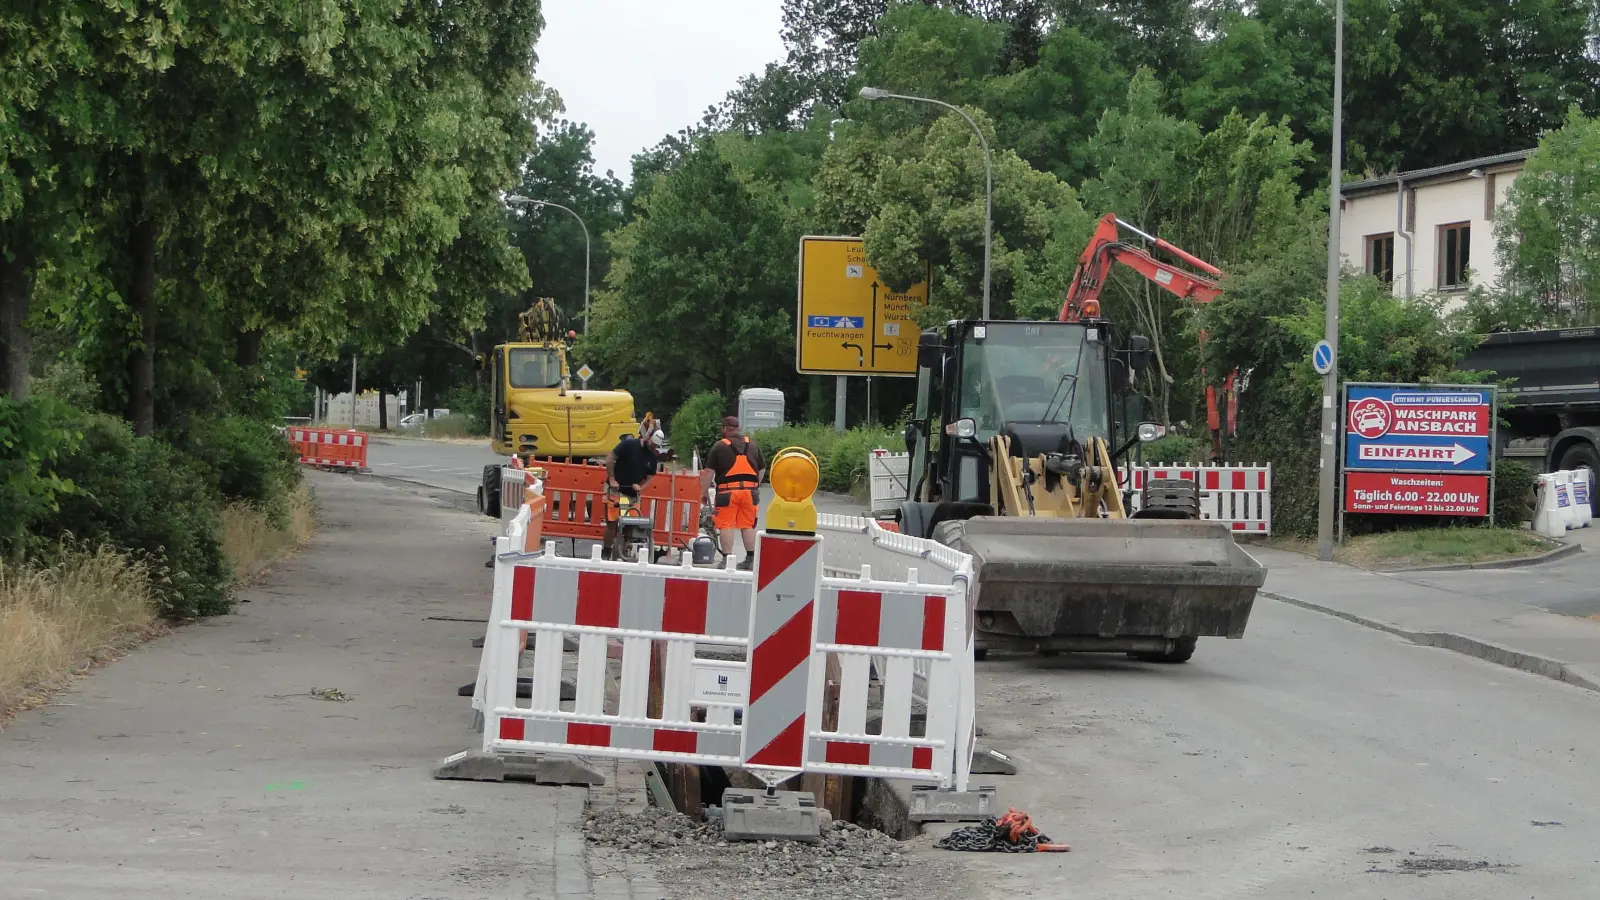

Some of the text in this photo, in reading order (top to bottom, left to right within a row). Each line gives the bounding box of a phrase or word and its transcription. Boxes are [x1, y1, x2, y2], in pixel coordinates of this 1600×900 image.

[847, 255, 867, 263] Scha
[884, 293, 922, 302] Nürnberg
[884, 303, 912, 311] Münch
[807, 330, 865, 340] Feuchtwangen
[1395, 410, 1477, 421] WASCHPARK
[1395, 420, 1476, 432] ANSBACH
[1364, 447, 1455, 459] EINFAHRT
[1390, 477, 1444, 487] Waschzeiten:
[1353, 489, 1392, 502] Täglich
[1394, 491, 1418, 502] 6.00
[1426, 492, 1457, 503] 22.00
[1459, 492, 1480, 503] Uhr
[1353, 502, 1374, 510] Sonn-
[1389, 504, 1423, 512] Feiertage
[1467, 505, 1479, 513] Uhr
